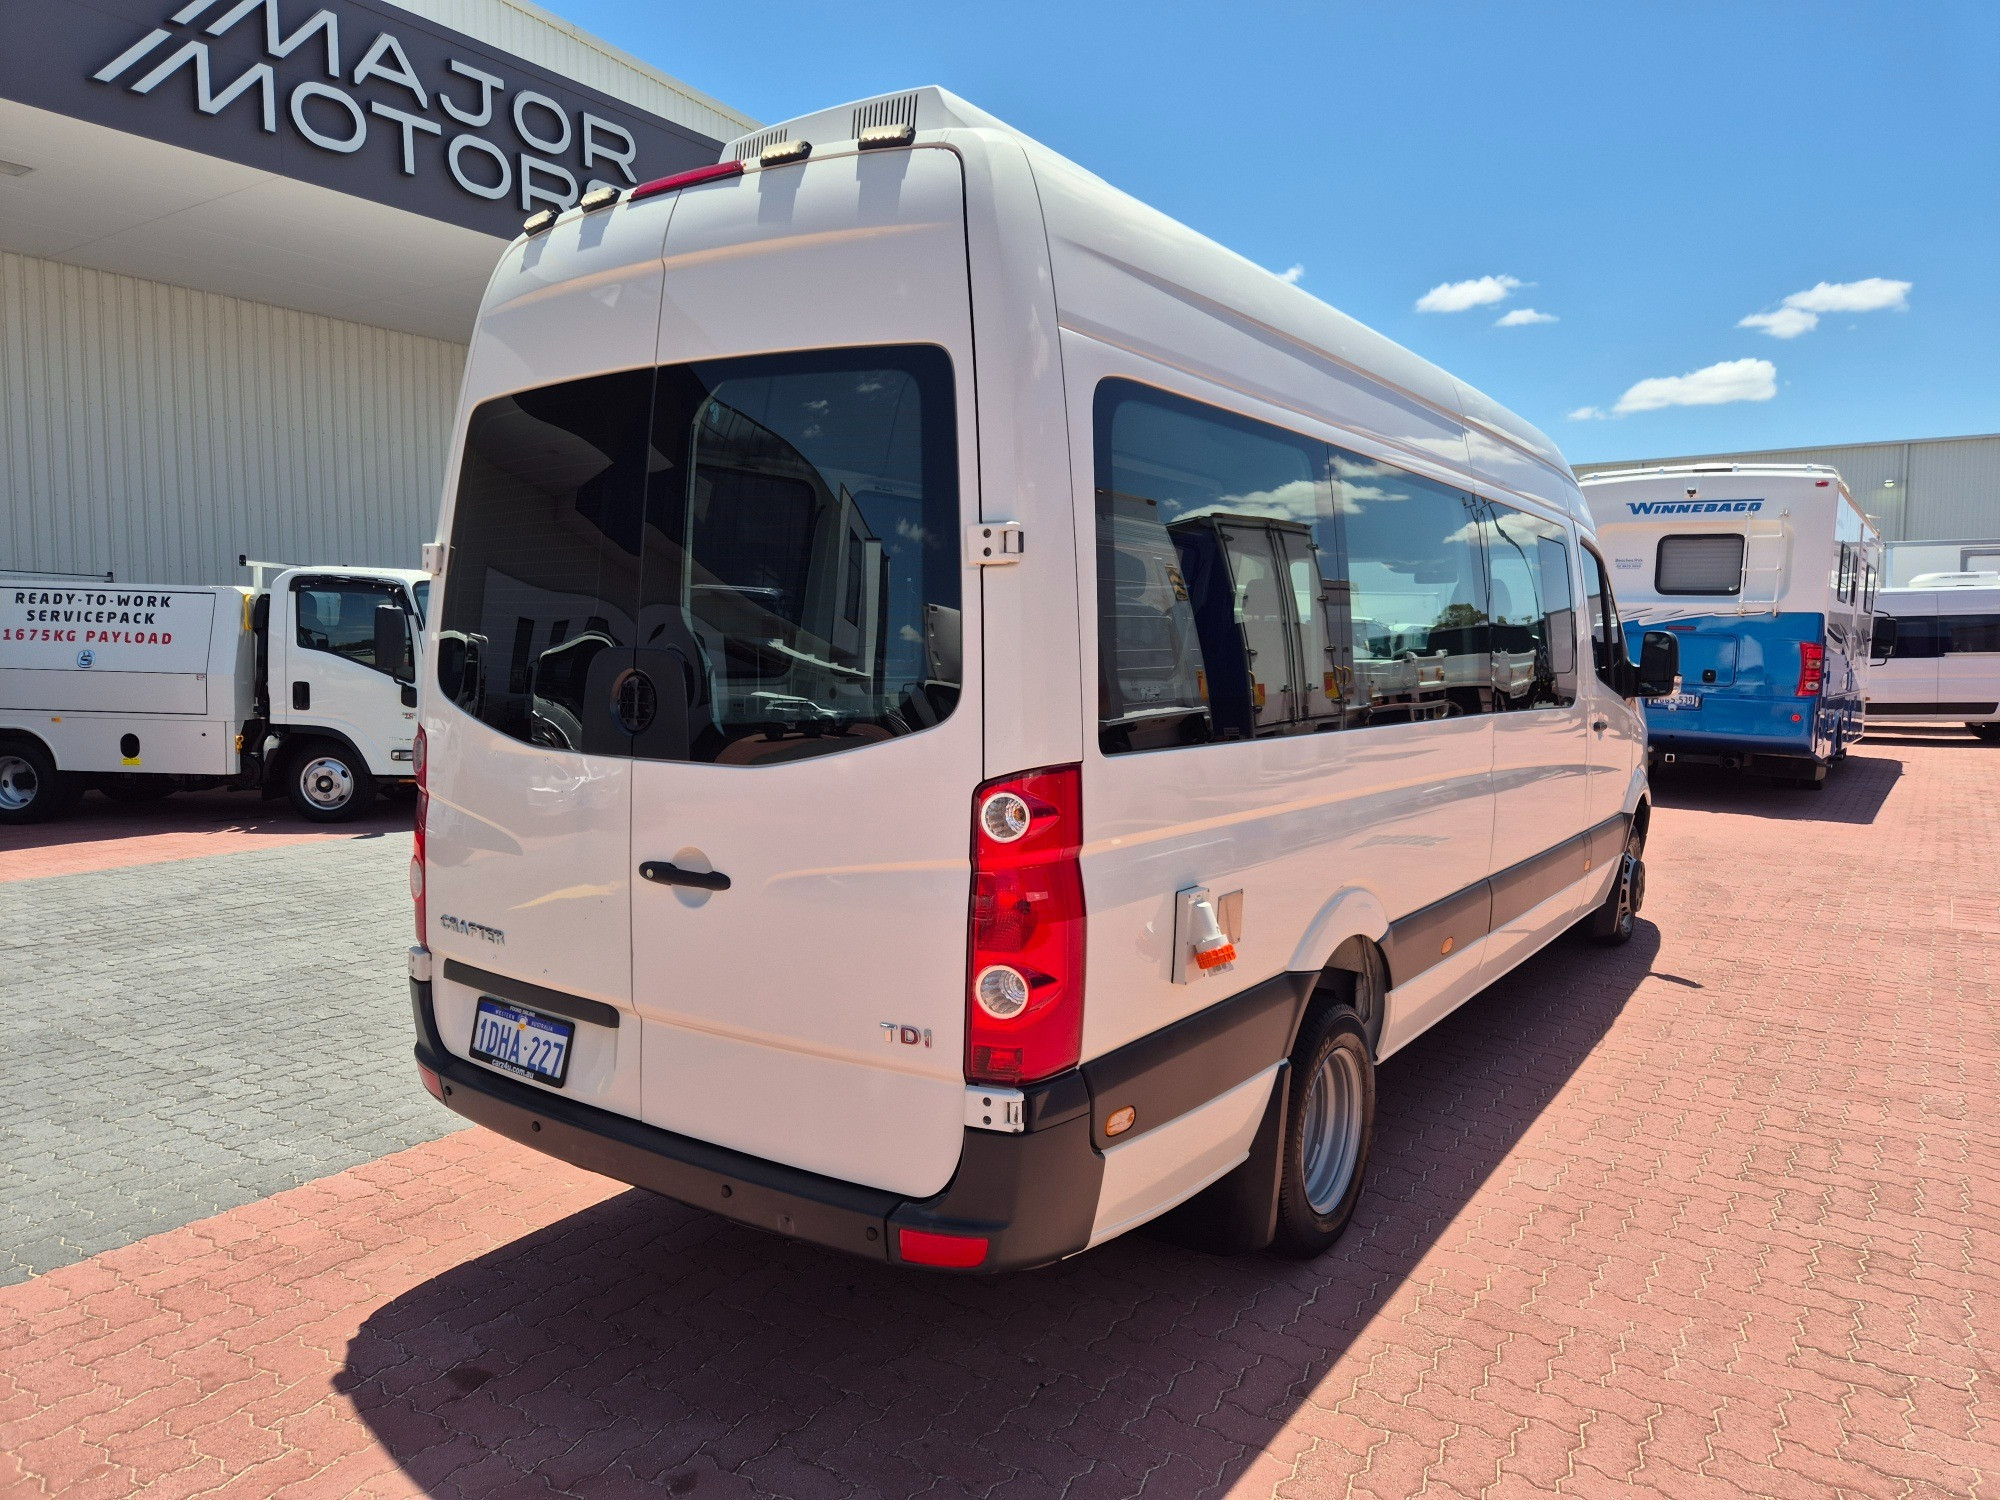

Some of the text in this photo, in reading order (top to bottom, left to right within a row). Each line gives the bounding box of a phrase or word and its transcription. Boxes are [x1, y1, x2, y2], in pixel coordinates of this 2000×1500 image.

[203, 0, 638, 184] MAJOR
[129, 40, 625, 213] MOTOR
[1626, 500, 1764, 515] WINNEBAGO
[15, 592, 172, 608] READY-TO-WORK
[26, 609, 156, 625] SERVICEPACK
[2, 628, 173, 645] 1675KG PAYLOAD
[440, 914, 505, 946] CRAFTER
[495, 1009, 553, 1032] WESTERN AUSTRALIA
[879, 1021, 933, 1049] TDI
[491, 1059, 535, 1079] carz4u.com.au
